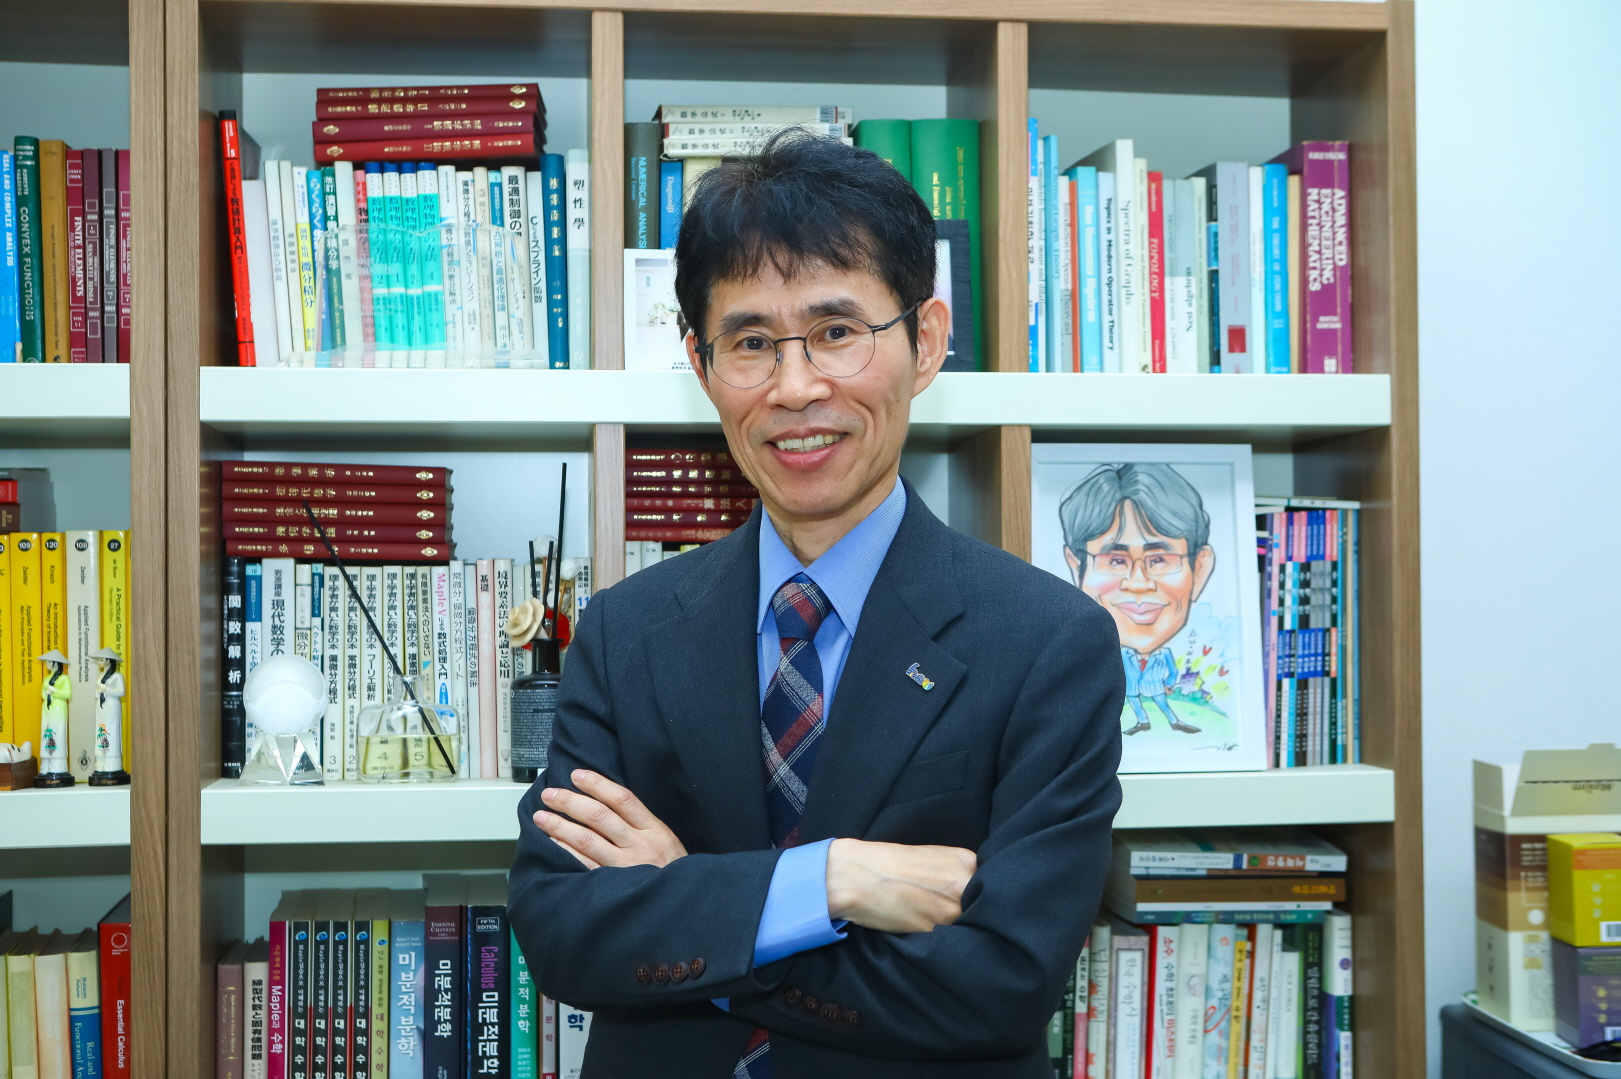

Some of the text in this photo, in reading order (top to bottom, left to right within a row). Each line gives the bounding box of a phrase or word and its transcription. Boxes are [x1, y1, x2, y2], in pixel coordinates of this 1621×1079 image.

[4, 192, 12, 229] COMPLEX
[508, 174, 523, 237] 最適制御の
[638, 156, 648, 249] NUMERICAL ANALYSI
[665, 176, 676, 213] Dugundji
[6, 231, 14, 267] ANALYSIS
[1307, 187, 1322, 292] MATHEMATICS
[1320, 187, 1335, 285] ENGINEERING
[1333, 187, 1348, 266] ADVANCED
[20, 206, 34, 321] CONVEX FUNCTIONS
[74, 216, 84, 297] FINITE ELEMENTS
[530, 215, 544, 304] Cによるスプライン関数
[1052, 248, 1060, 281] Theory
[1104, 197, 1116, 351] Topics in Modern Operator Theory
[1120, 200, 1134, 306] Spectra of Graphs
[1149, 237, 1160, 300] TOPOLOGY
[302, 261, 315, 308] 微分積分
[377, 275, 384, 285] 2
[395, 273, 400, 284] 1
[410, 274, 416, 285] 3
[428, 271, 434, 281] 4
[1183, 267, 1194, 333] Nest algebras
[19, 541, 31, 551] 109
[46, 541, 58, 551] 120
[76, 541, 88, 551] 108
[110, 541, 119, 551] 27
[479, 574, 490, 593] 基礎
[53, 602, 59, 611] An
[227, 594, 243, 685] 関数解析
[248, 628, 260, 671] ヒルベルト空
[83, 658, 91, 683] Analysis
[328, 653, 339, 705] 偏微分方程式
[346, 653, 358, 701] 常微分方程式
[365, 653, 377, 702] フーリエ解析
[328, 755, 336, 766] 3
[348, 755, 356, 765] 2
[377, 751, 389, 761] 4
[413, 751, 425, 762] 5
[269, 985, 284, 1054] Maple과 수학
[396, 951, 417, 1058] 미분적분학
[434, 959, 452, 1039] 미분적분학
[478, 946, 501, 1075] Calculus 미분적분학
[74, 1022, 84, 1064] Functional
[116, 999, 126, 1069] Essential Calculus
[86, 1041, 96, 1076] Real and
